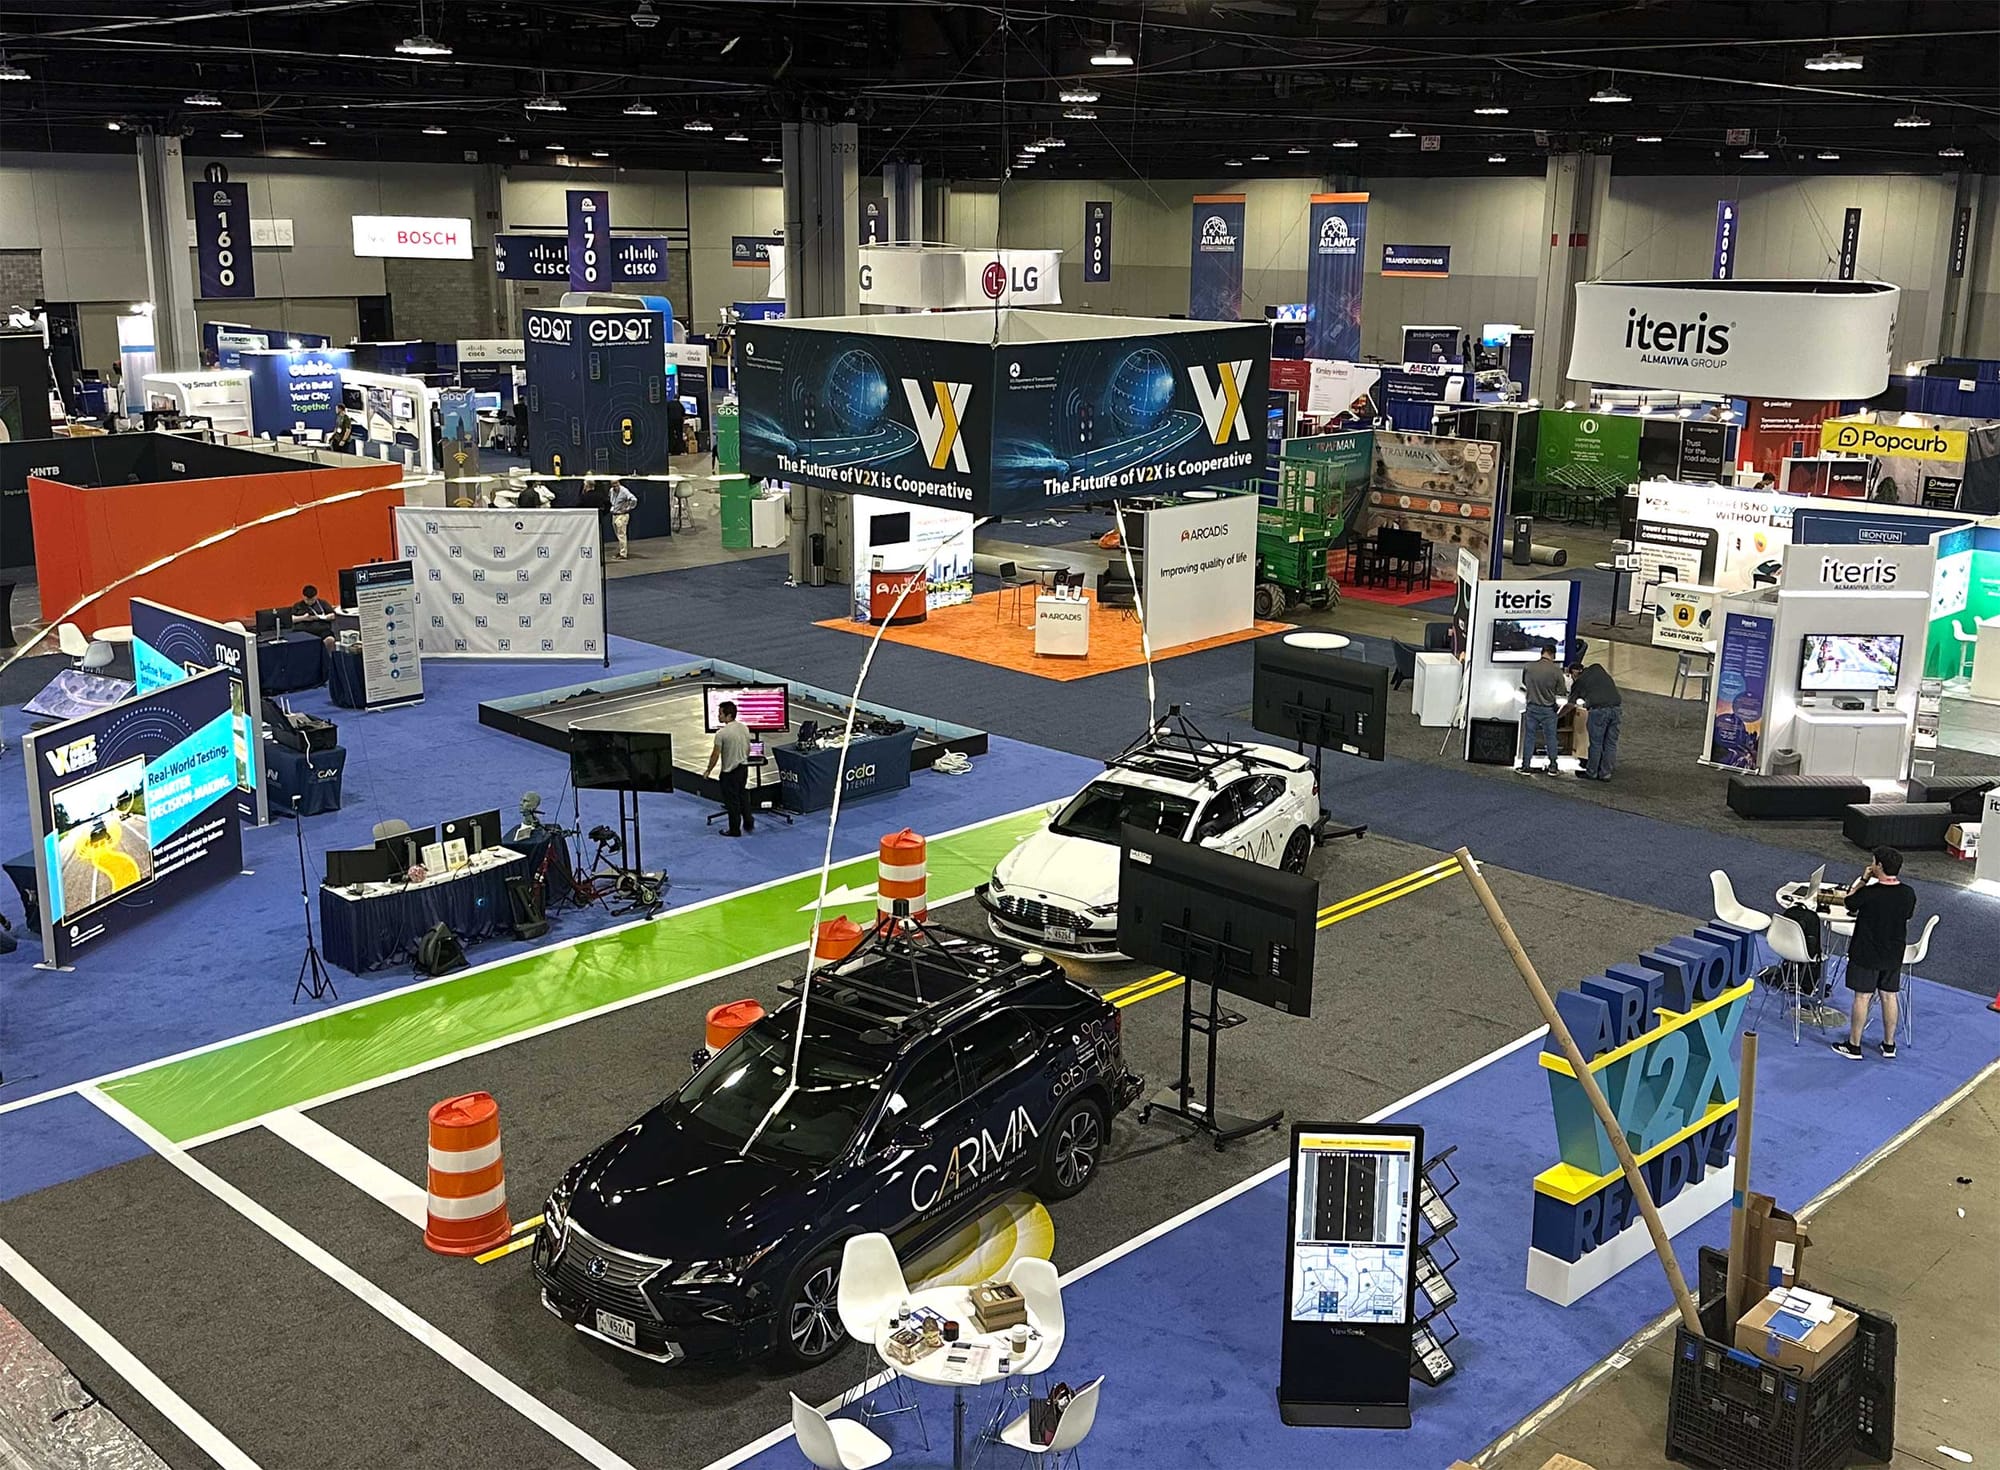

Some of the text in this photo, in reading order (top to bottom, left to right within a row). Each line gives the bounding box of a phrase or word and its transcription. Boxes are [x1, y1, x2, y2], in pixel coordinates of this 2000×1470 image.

[397, 230, 458, 245] BOSCH
[1200, 235, 1237, 245] ATLANTA
[1318, 237, 1360, 248] ATLANTA
[217, 211, 235, 286] 1600
[584, 216, 597, 283] 1700
[1093, 222, 1102, 275] 1900
[1719, 222, 1731, 280] 2000
[1843, 227, 1854, 279] 2100
[623, 262, 657, 276] CISCO
[1011, 265, 1039, 292] LG
[528, 315, 573, 341] GDOT
[588, 317, 653, 342] GDOT
[1624, 307, 1731, 356] iteris
[496, 346, 525, 355] Secure
[1640, 353, 1728, 369] ALMAVIVA GROUP
[193, 380, 218, 389] Smart
[291, 402, 332, 413] Together.
[1862, 430, 1948, 453] Popcurb
[30, 465, 60, 477] HNTB
[777, 454, 974, 501] The Future of V2X is Cooperative
[1043, 450, 1253, 496] The Future of V2X is Cooperative
[1715, 511, 1767, 524] WITHOUT
[1752, 501, 1769, 513] NO
[1190, 523, 1229, 541] ARCADIS
[1860, 530, 1901, 542] IRONYUN
[1160, 551, 1248, 579] Improving quality of life
[1822, 557, 1897, 584] iteris
[1494, 589, 1552, 610] iteris
[1047, 611, 1082, 623] ARCADIS
[1659, 630, 1677, 639] SCMS
[1677, 633, 1690, 641] FOR
[1691, 635, 1704, 643] V2X
[148, 744, 230, 787] Real-World Testing.
[845, 763, 876, 782] cda
[910, 1104, 1040, 1213] CARMA
